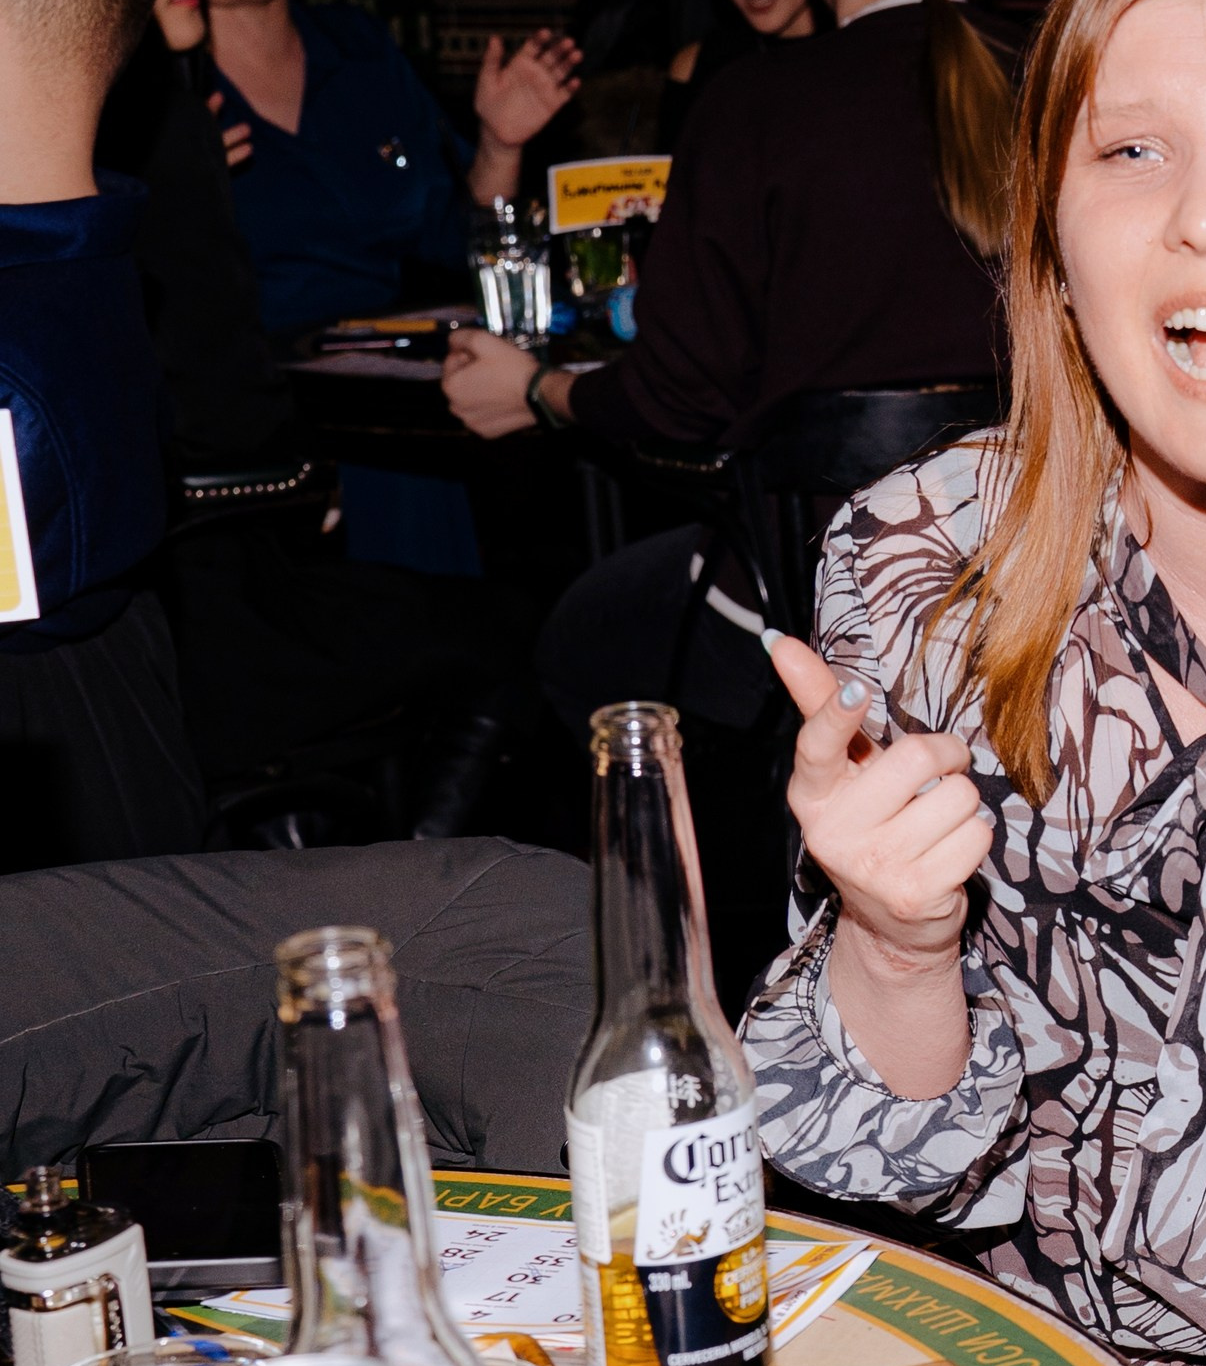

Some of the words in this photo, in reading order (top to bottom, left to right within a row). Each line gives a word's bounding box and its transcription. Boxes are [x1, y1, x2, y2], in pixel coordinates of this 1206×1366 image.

[663, 1125, 756, 1188] Coro
[466, 1230, 508, 1242] 24
[440, 1247, 484, 1260] 28
[529, 1255, 574, 1267] 35
[507, 1272, 551, 1285] 30
[484, 1291, 520, 1303] 17
[855, 1269, 979, 1329] ШАХМА
[469, 1310, 493, 1321] 4
